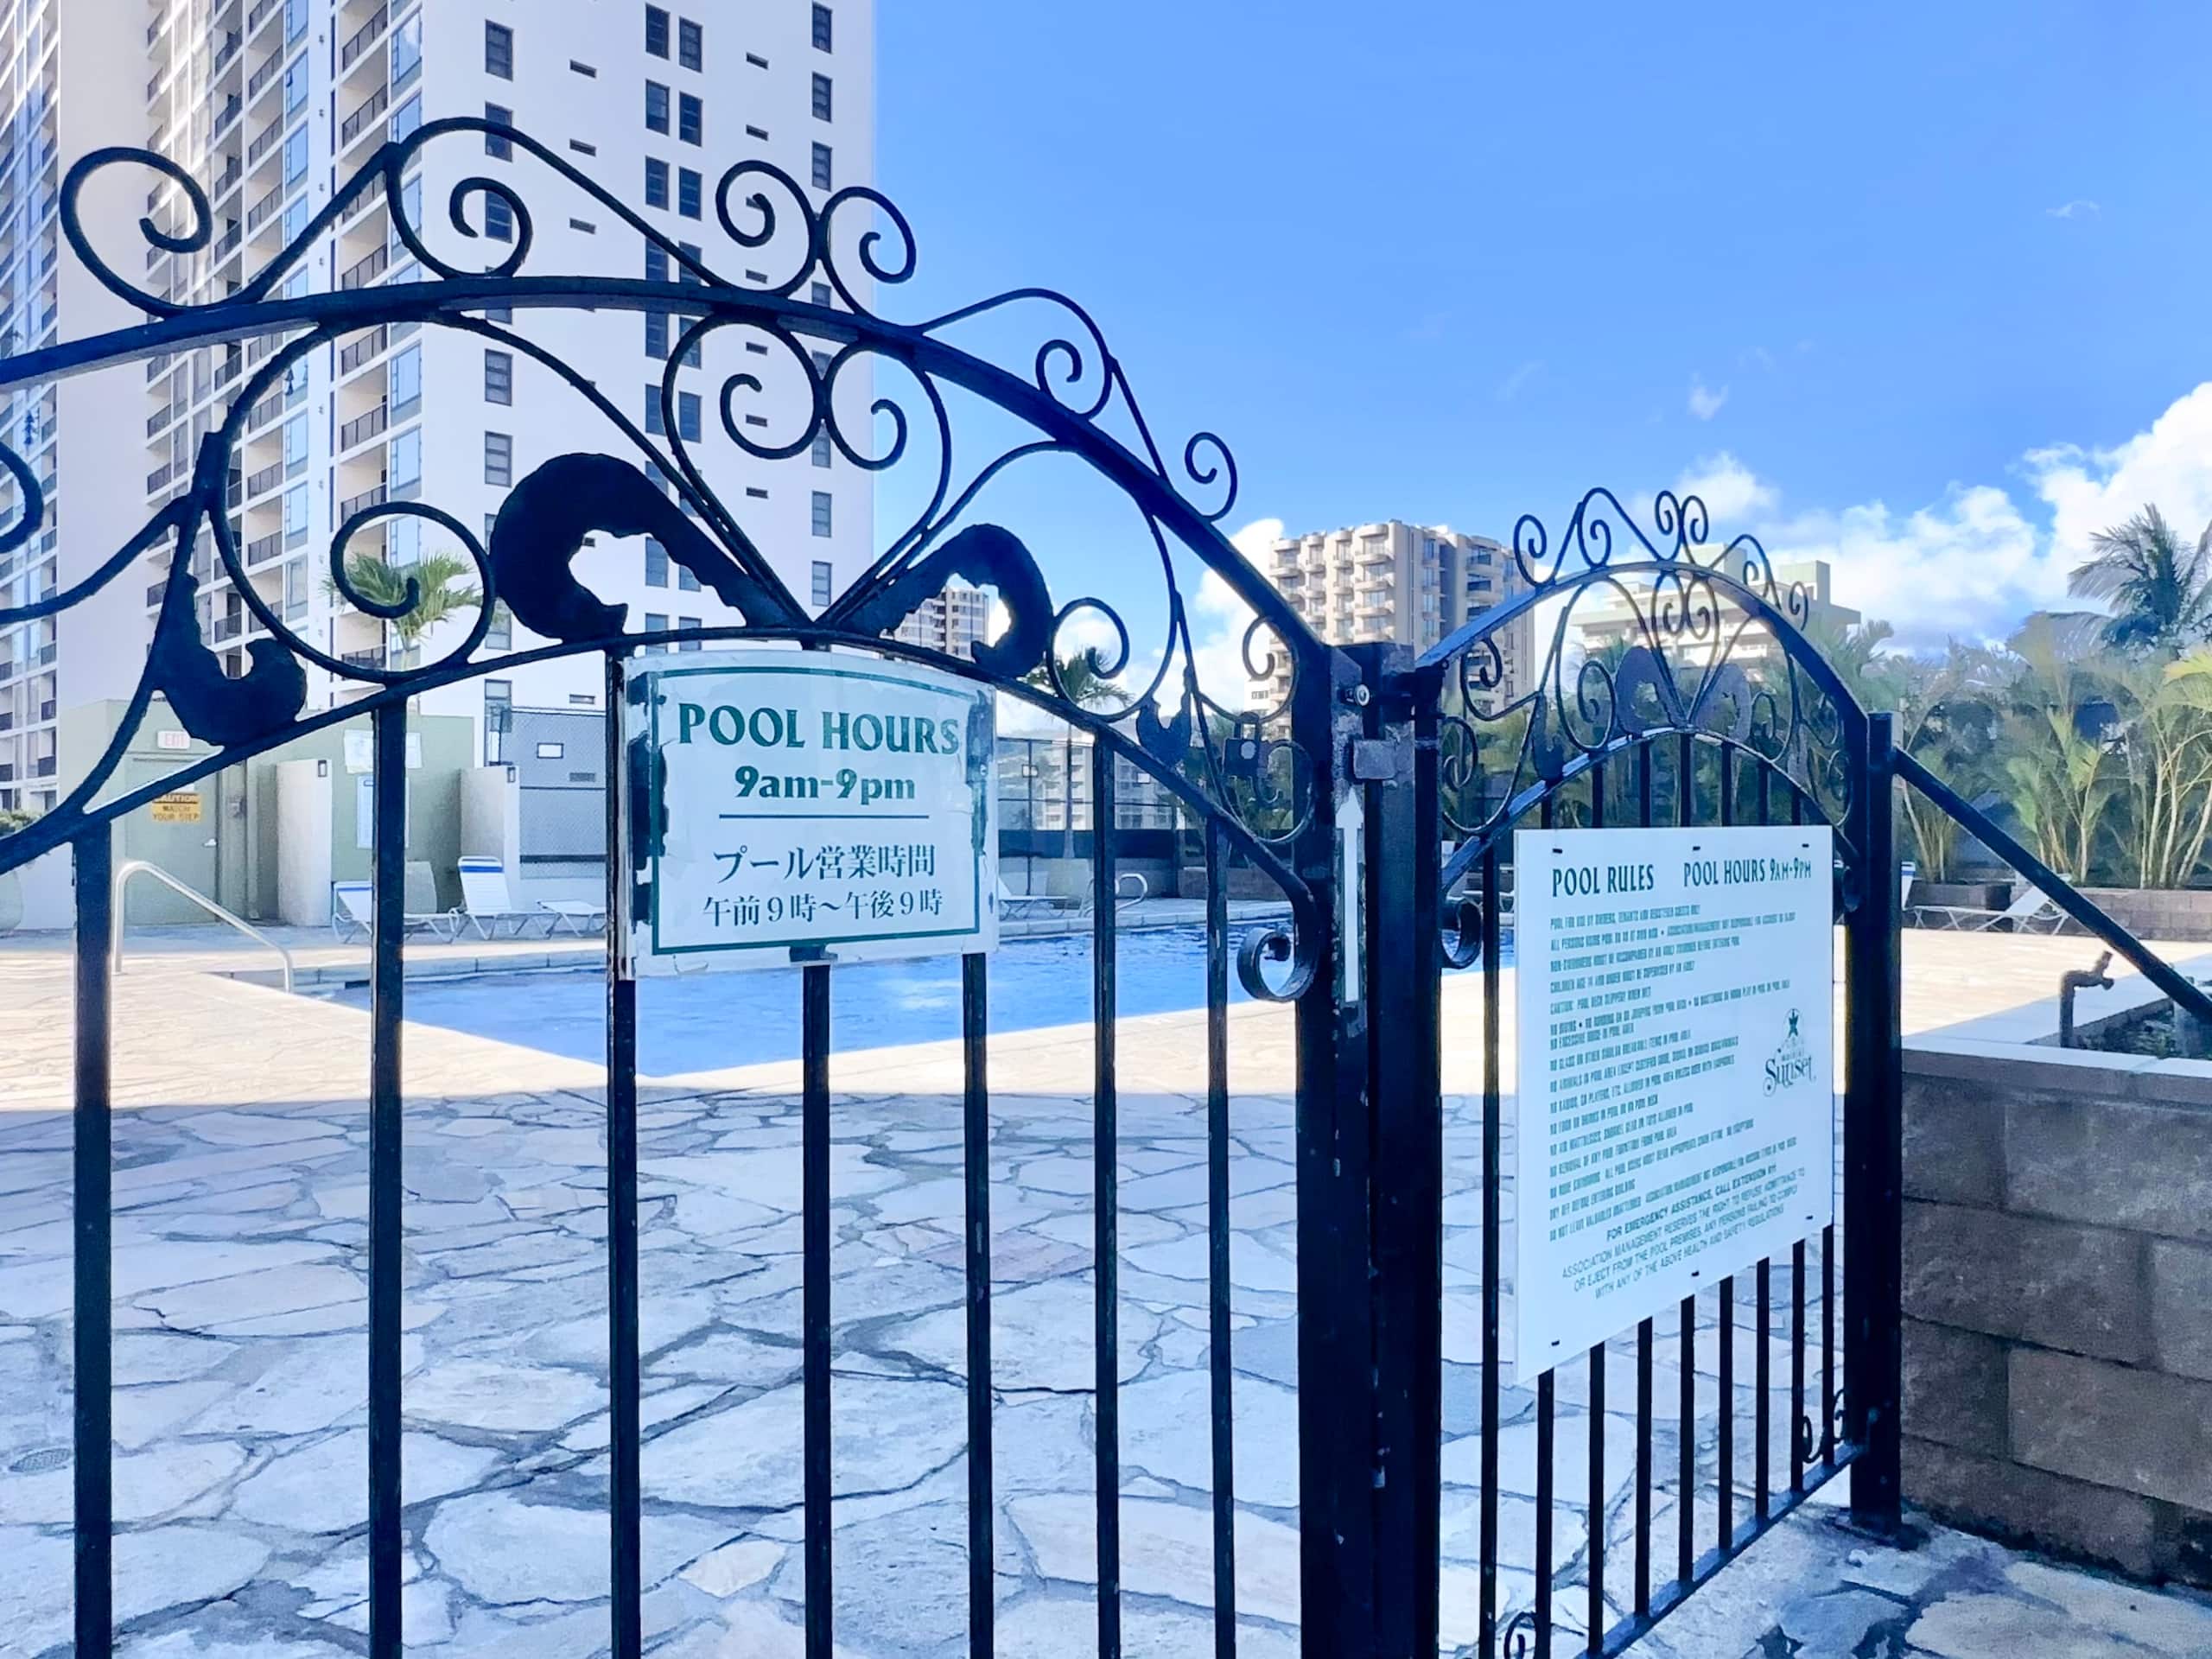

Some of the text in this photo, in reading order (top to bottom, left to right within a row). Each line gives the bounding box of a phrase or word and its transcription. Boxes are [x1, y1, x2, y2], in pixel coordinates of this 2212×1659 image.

[678, 702, 961, 755] POOL HOURS
[734, 766, 915, 805] 9am-9pm
[713, 844, 936, 883] プール営業時間
[1553, 864, 1654, 897] POOL RULES
[1684, 861, 1719, 887] POOL
[1724, 859, 1765, 885] HOURS
[1763, 1056, 1812, 1096] Sunset
[1606, 1223, 1623, 1243] FOR
[1624, 1205, 1668, 1235] EMERGENCY
[1714, 1180, 1730, 1198] CALL
[1562, 1245, 1612, 1281] ASSOCIATION
[1573, 1274, 1586, 1293] OR
[1586, 1263, 1610, 1287] EJECT
[1611, 1254, 1633, 1275] FROM
[1635, 1247, 1648, 1266] THE
[1649, 1238, 1668, 1259] POOL
[1617, 1271, 1630, 1289] ANY
[1645, 1259, 1657, 1276] THE
[1660, 1248, 1681, 1269] ABOVE
